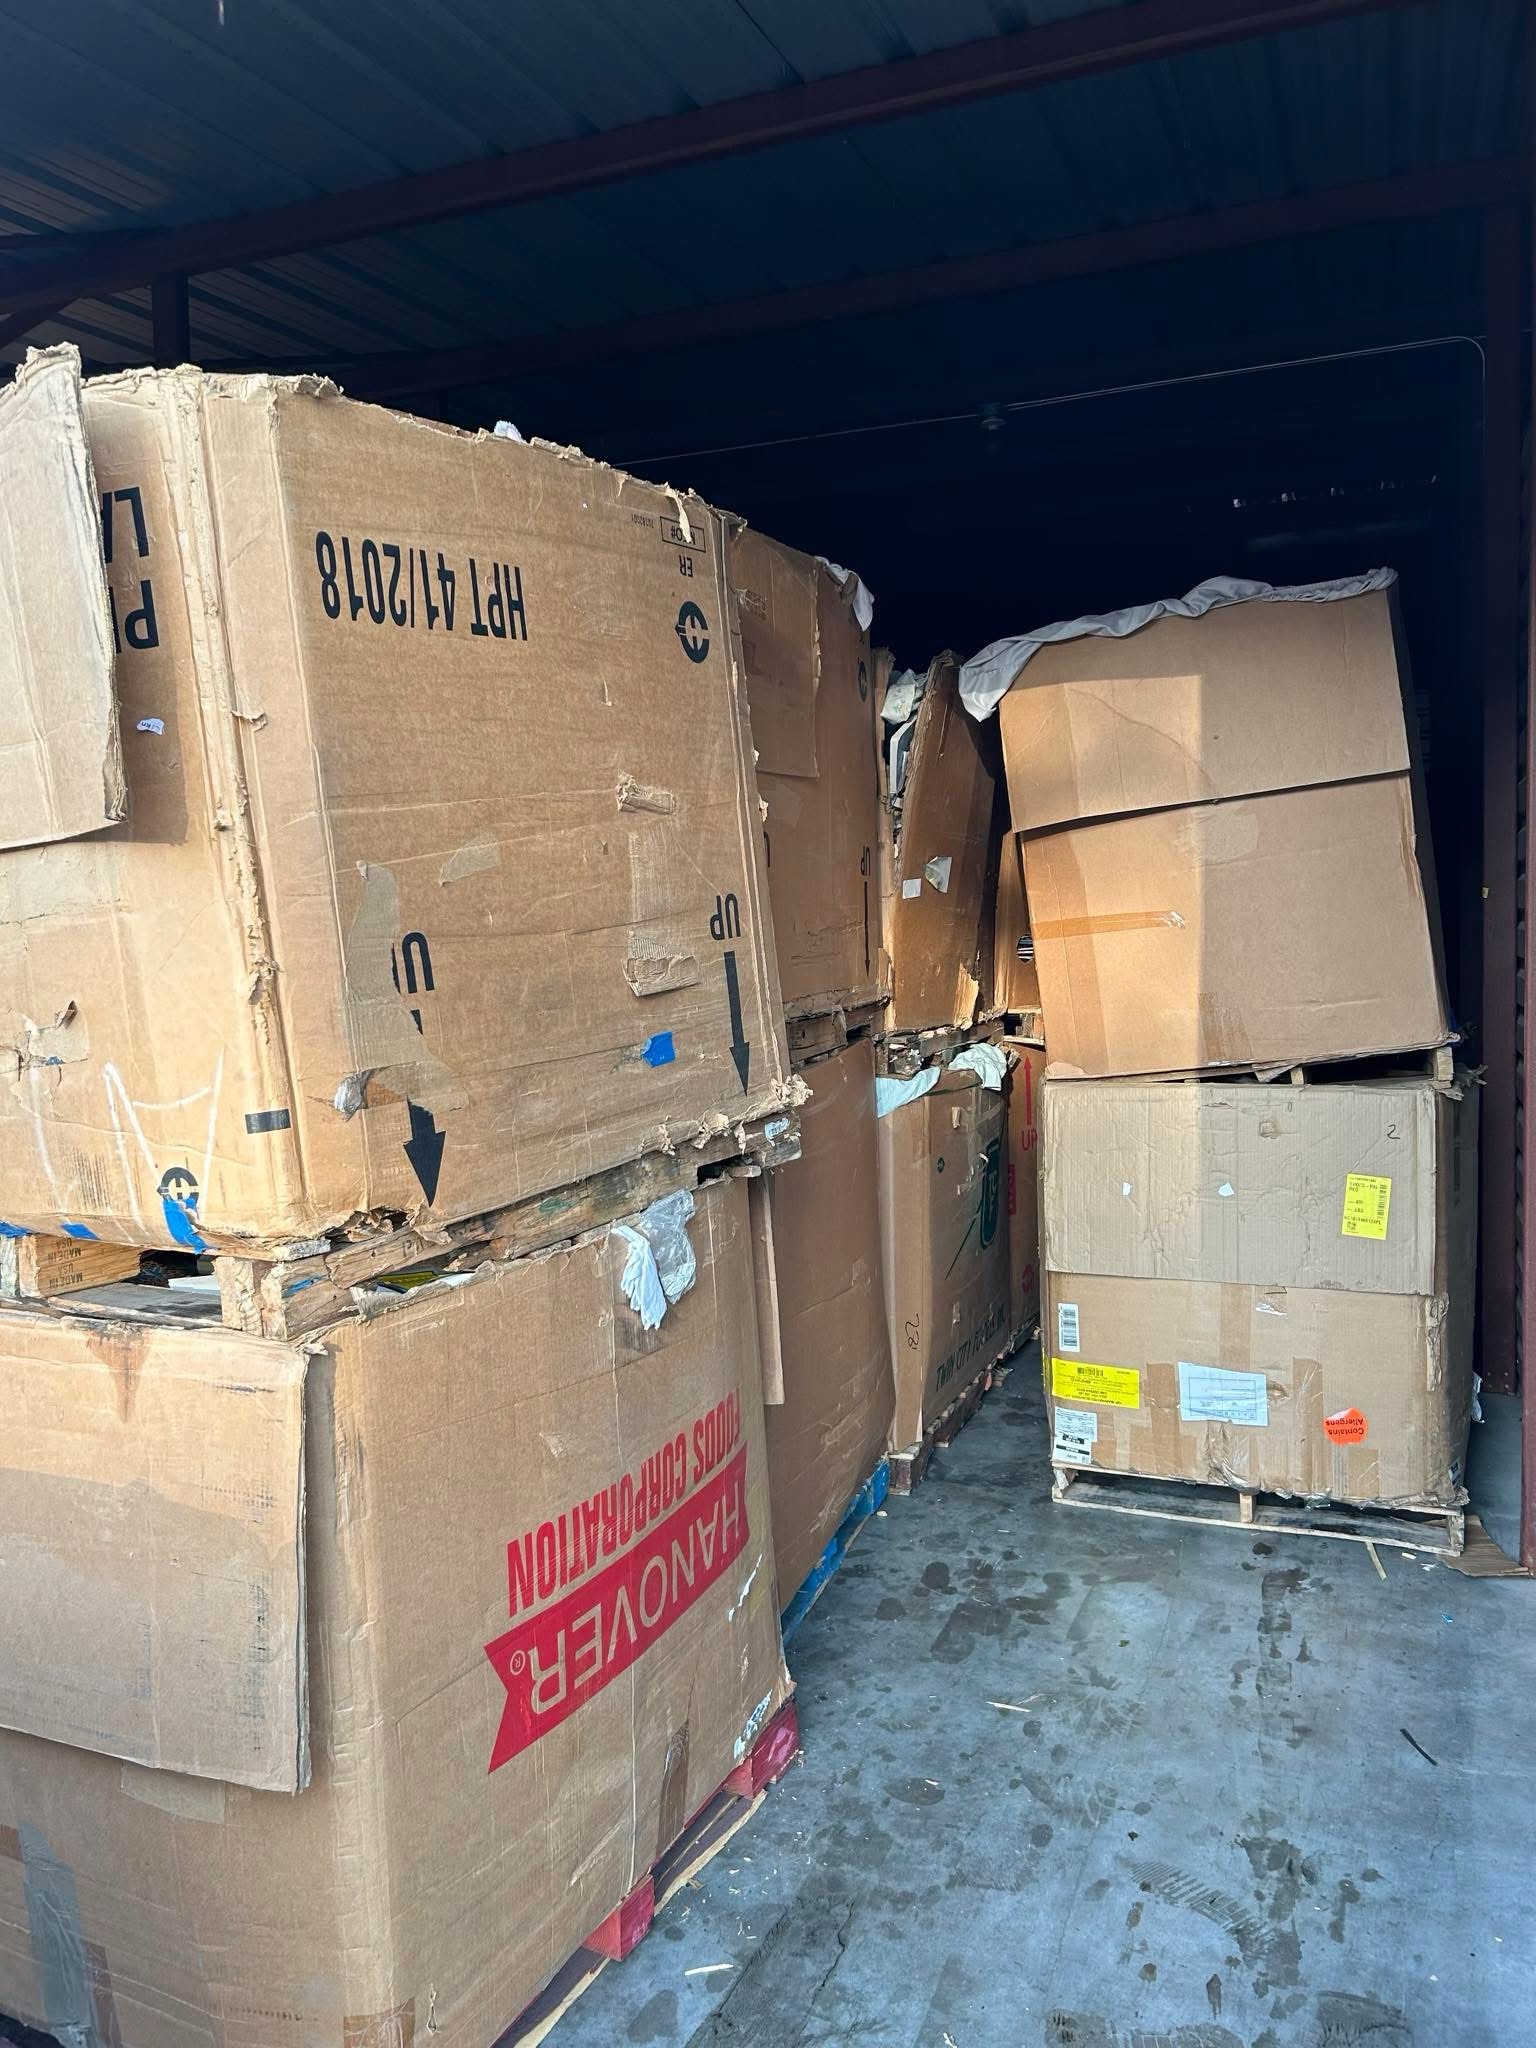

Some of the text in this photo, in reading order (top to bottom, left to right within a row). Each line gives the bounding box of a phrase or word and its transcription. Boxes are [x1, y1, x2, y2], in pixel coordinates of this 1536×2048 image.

[679, 555, 694, 578] ER
[315, 531, 528, 641] HPT 41/2018
[860, 846, 871, 877] UP
[709, 893, 741, 941] UP
[390, 931, 435, 994] U
[1020, 1129, 1038, 1152] UP
[1386, 1123, 1401, 1140] 2
[56, 1238, 72, 1249] USA
[57, 1247, 81, 1262] MADE
[59, 1272, 83, 1287] MADE
[1325, 1417, 1364, 1427] Allergens
[1327, 1427, 1365, 1437] Contains
[506, 1386, 741, 1618] FOODS CORPORATION
[528, 1480, 741, 1714] HANOVER
